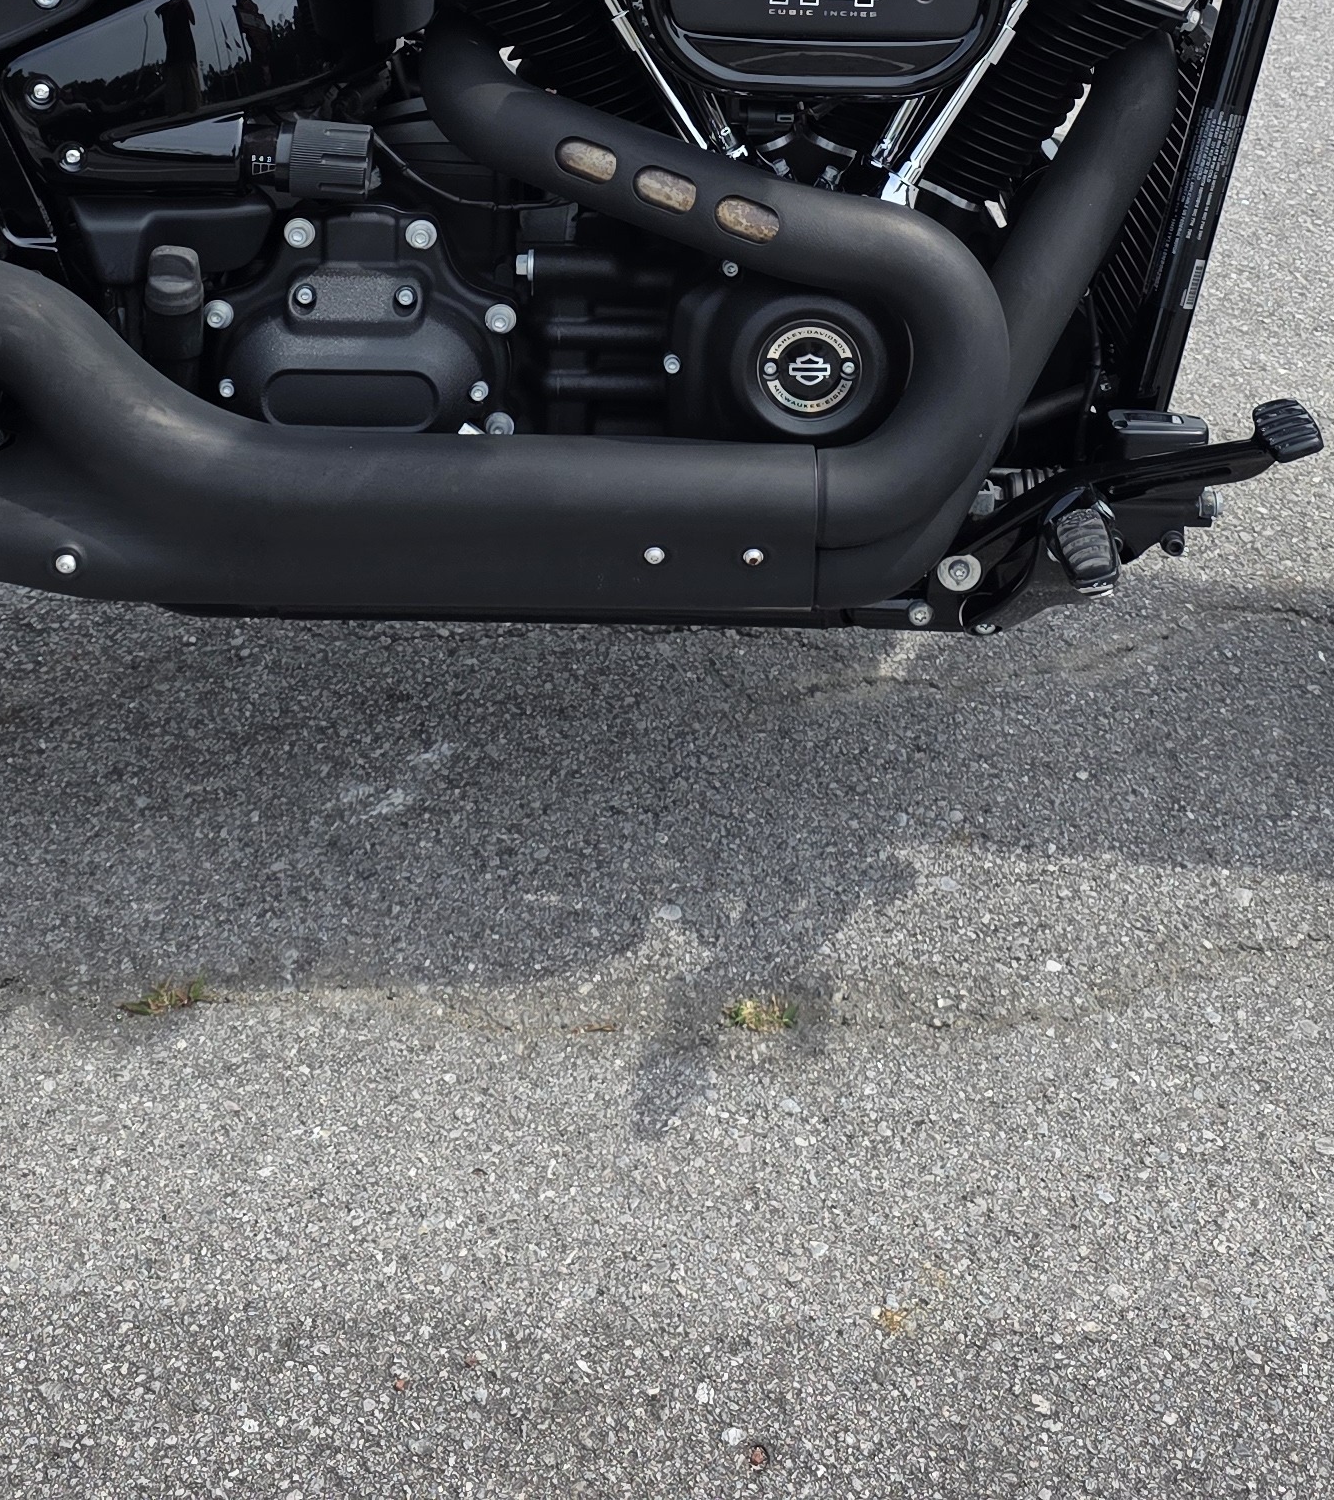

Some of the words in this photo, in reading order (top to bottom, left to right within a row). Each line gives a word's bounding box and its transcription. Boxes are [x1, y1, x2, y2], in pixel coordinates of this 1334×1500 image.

[768, 8, 814, 16] CUBIC
[823, 10, 878, 18] INCHES
[772, 329, 847, 354] HARLEY-DAVIDSON
[773, 383, 848, 409] MILWAUKEE-EIGHT
